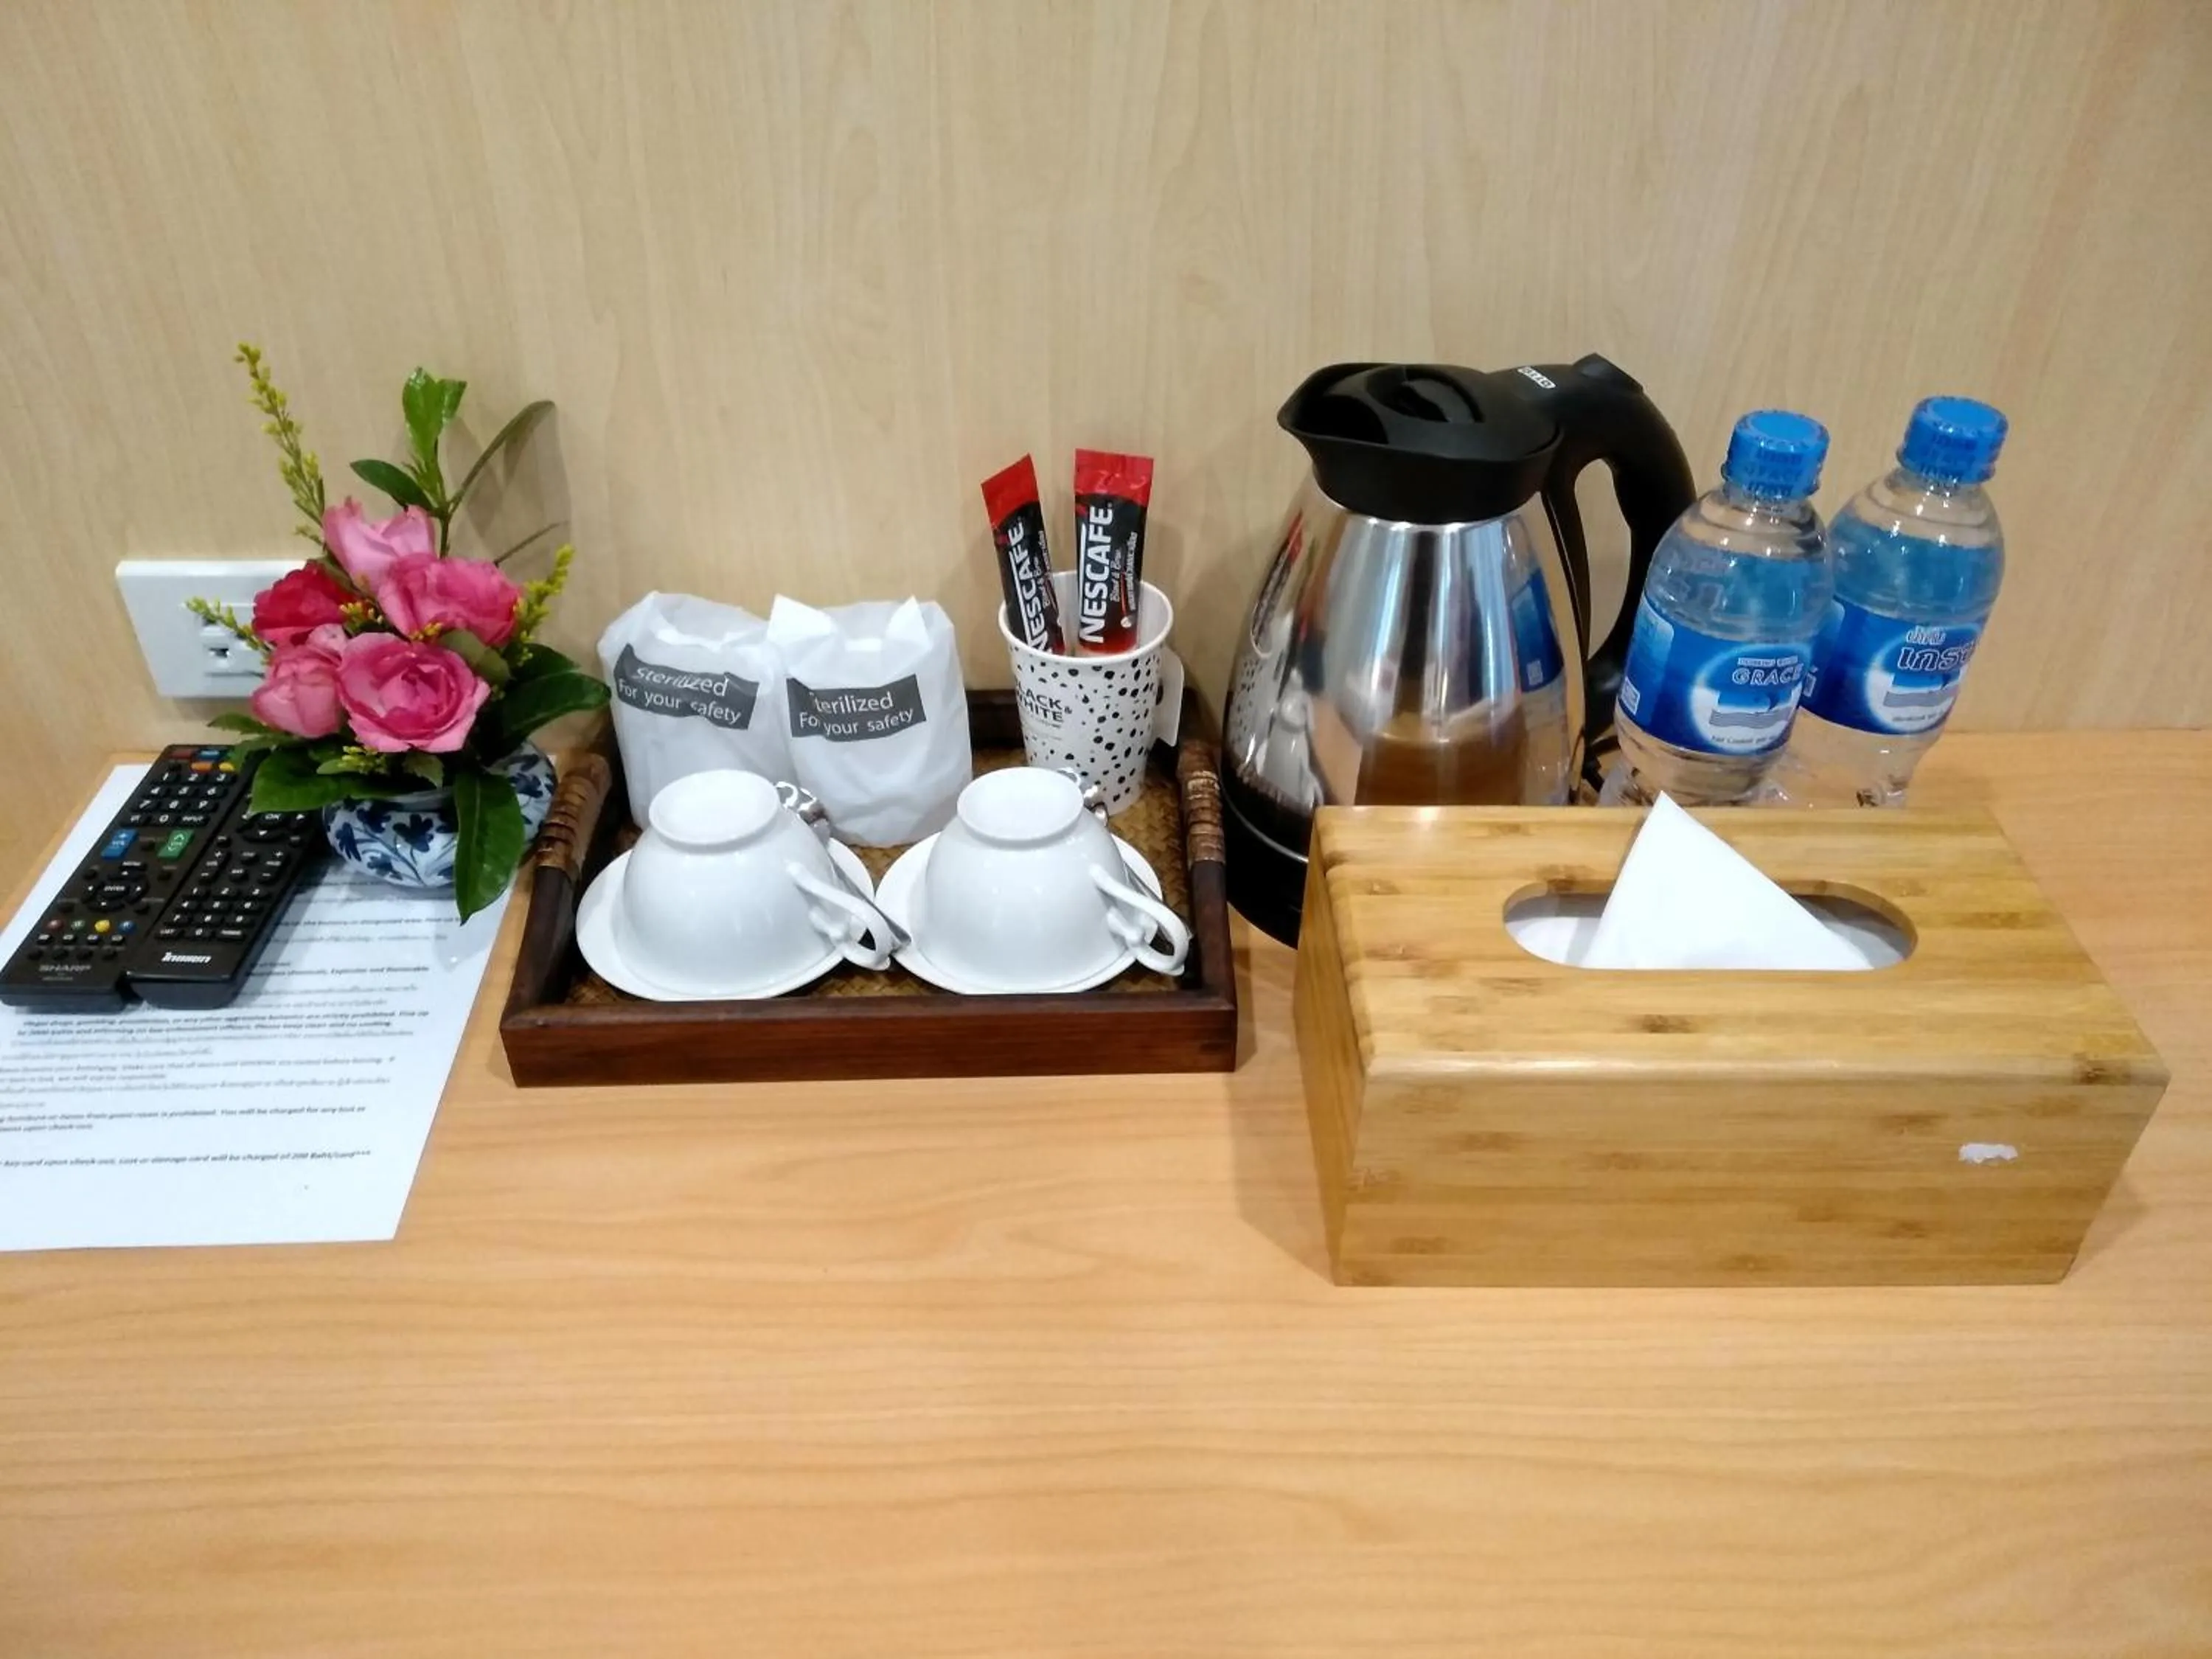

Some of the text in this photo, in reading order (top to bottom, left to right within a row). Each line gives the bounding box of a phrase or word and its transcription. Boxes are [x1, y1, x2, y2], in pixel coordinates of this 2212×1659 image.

[618, 678, 742, 725] For your safety
[809, 691, 894, 714] terilized
[1015, 681, 1062, 710] LACK
[799, 708, 914, 737] Fo your safety
[161, 773, 226, 782] 1 2 3
[150, 787, 217, 796] 4 5 6
[139, 800, 209, 809] 7 8 9
